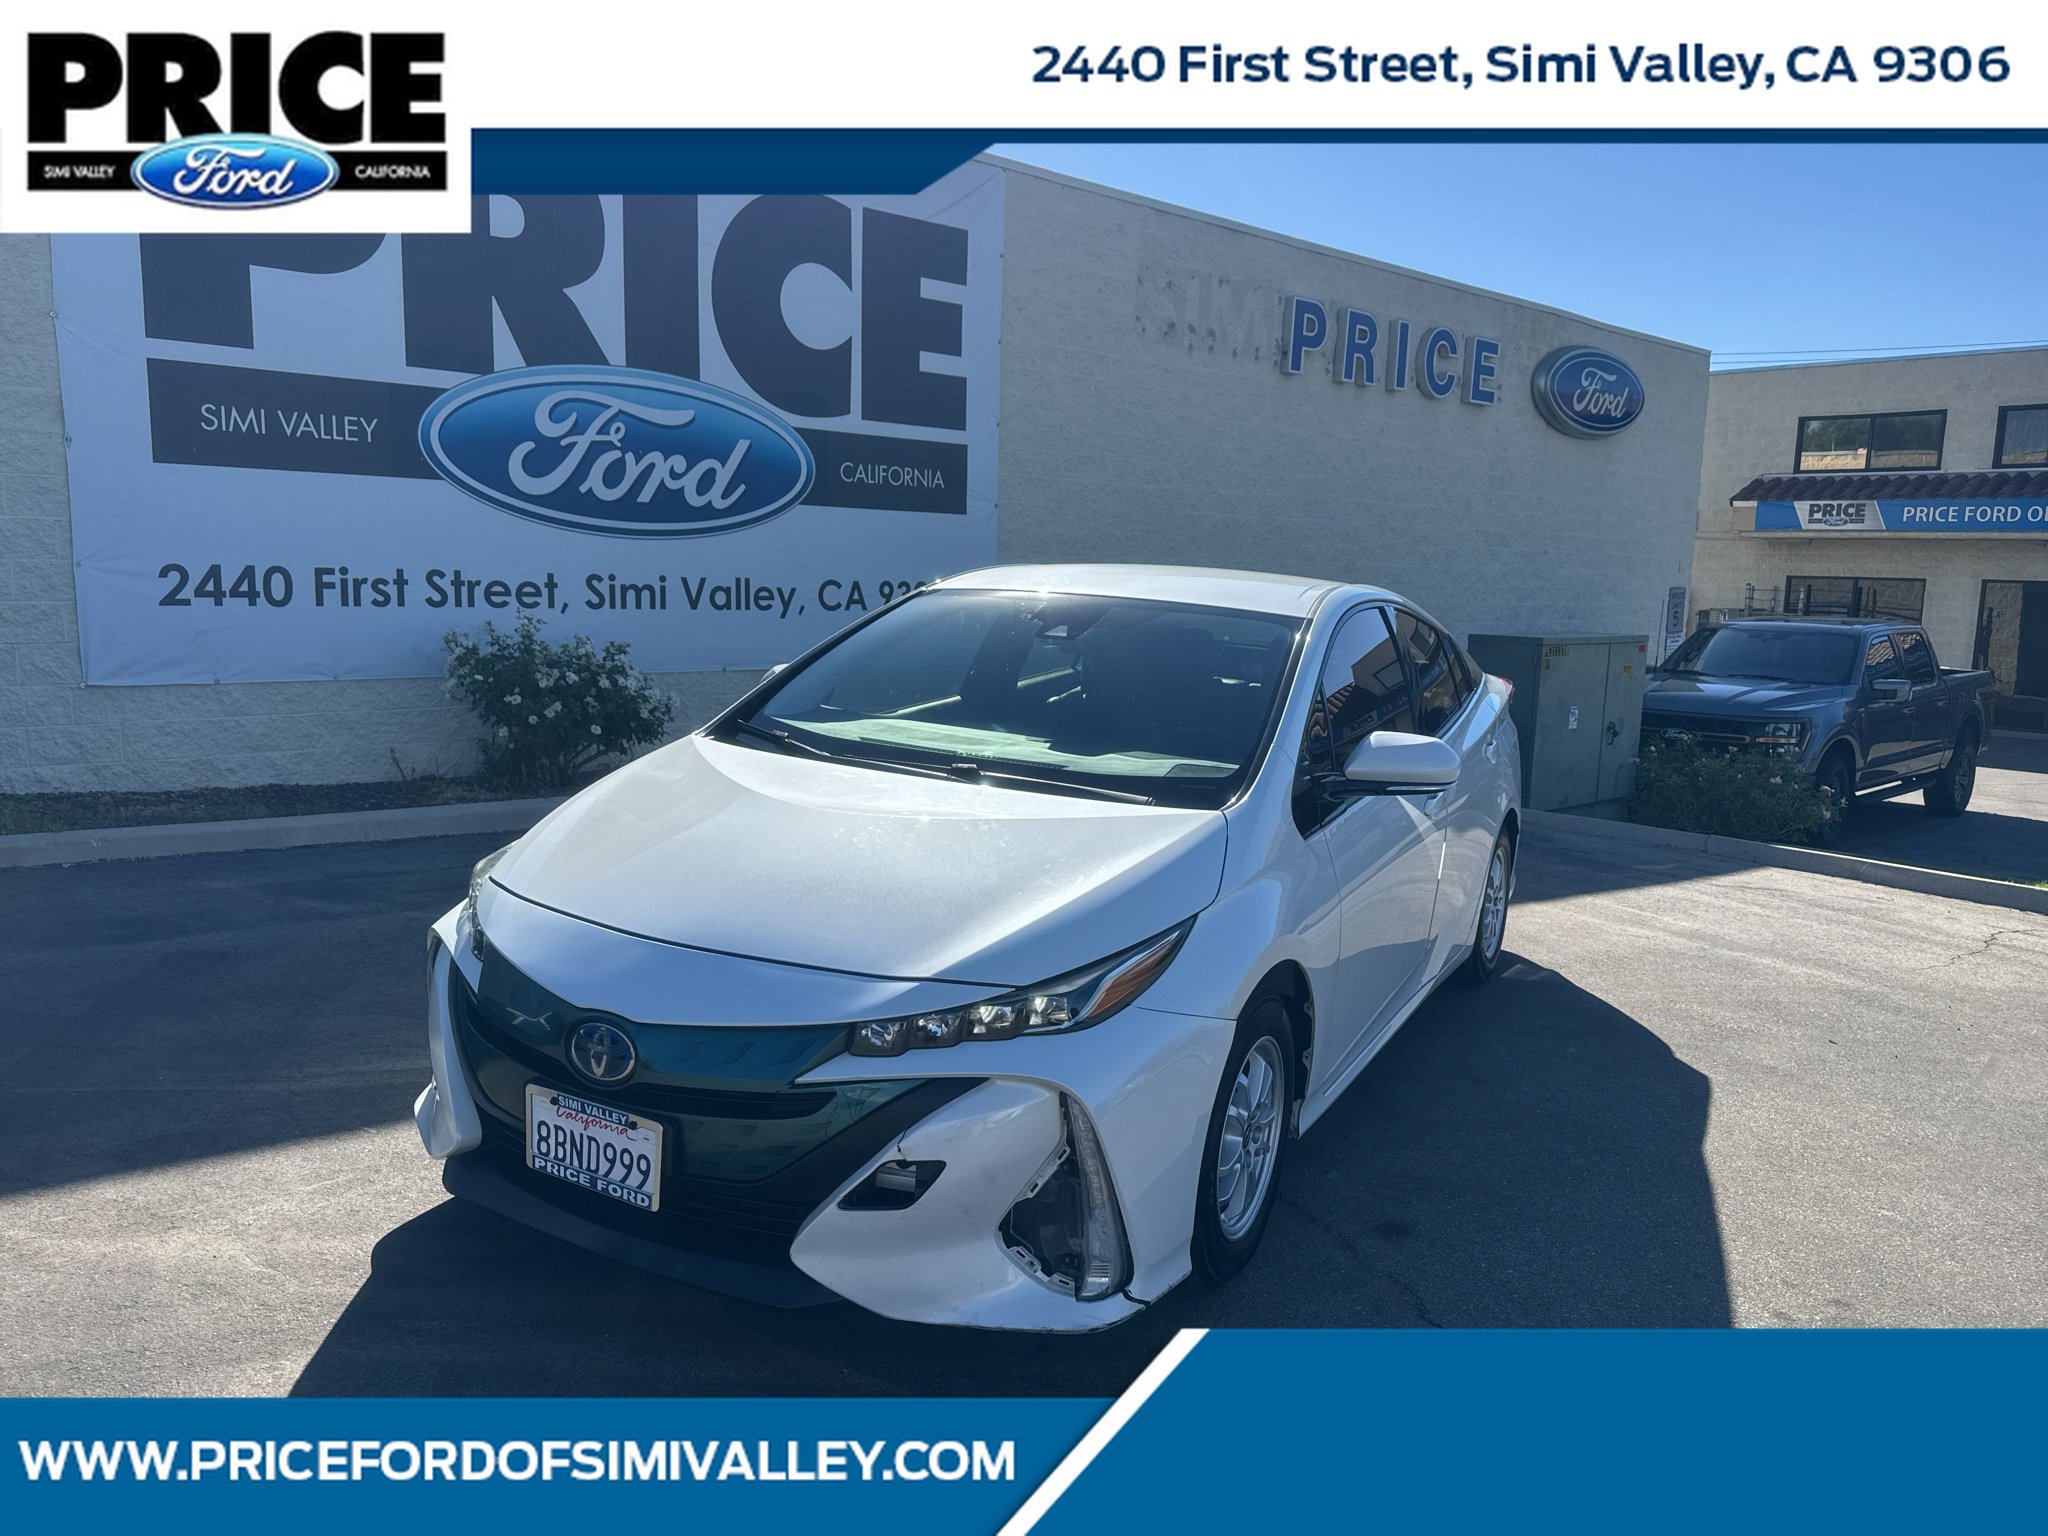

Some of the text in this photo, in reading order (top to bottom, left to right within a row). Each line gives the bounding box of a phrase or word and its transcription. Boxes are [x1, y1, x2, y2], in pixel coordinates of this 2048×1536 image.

[1281, 295, 1500, 405] PRICE
[1573, 367, 1629, 418] Ford
[201, 403, 378, 442] SIMI VALLEY
[508, 390, 752, 509] Ford
[840, 461, 945, 488] CALIFORNIA
[1808, 503, 1866, 517] PRICE
[1902, 506, 1959, 522] PRICE
[1964, 506, 2022, 522] FORD
[158, 563, 293, 607] 2440
[314, 566, 409, 608] First
[424, 568, 569, 614] Street,
[585, 573, 667, 610] Simi
[680, 575, 805, 618] Valley,
[818, 579, 868, 611] CA
[1672, 610, 1680, 627] 5
[558, 1095, 628, 1126] SIMI VALLEY
[536, 1120, 651, 1190] 8BND999
[534, 1157, 650, 1207] PRICE FORD
